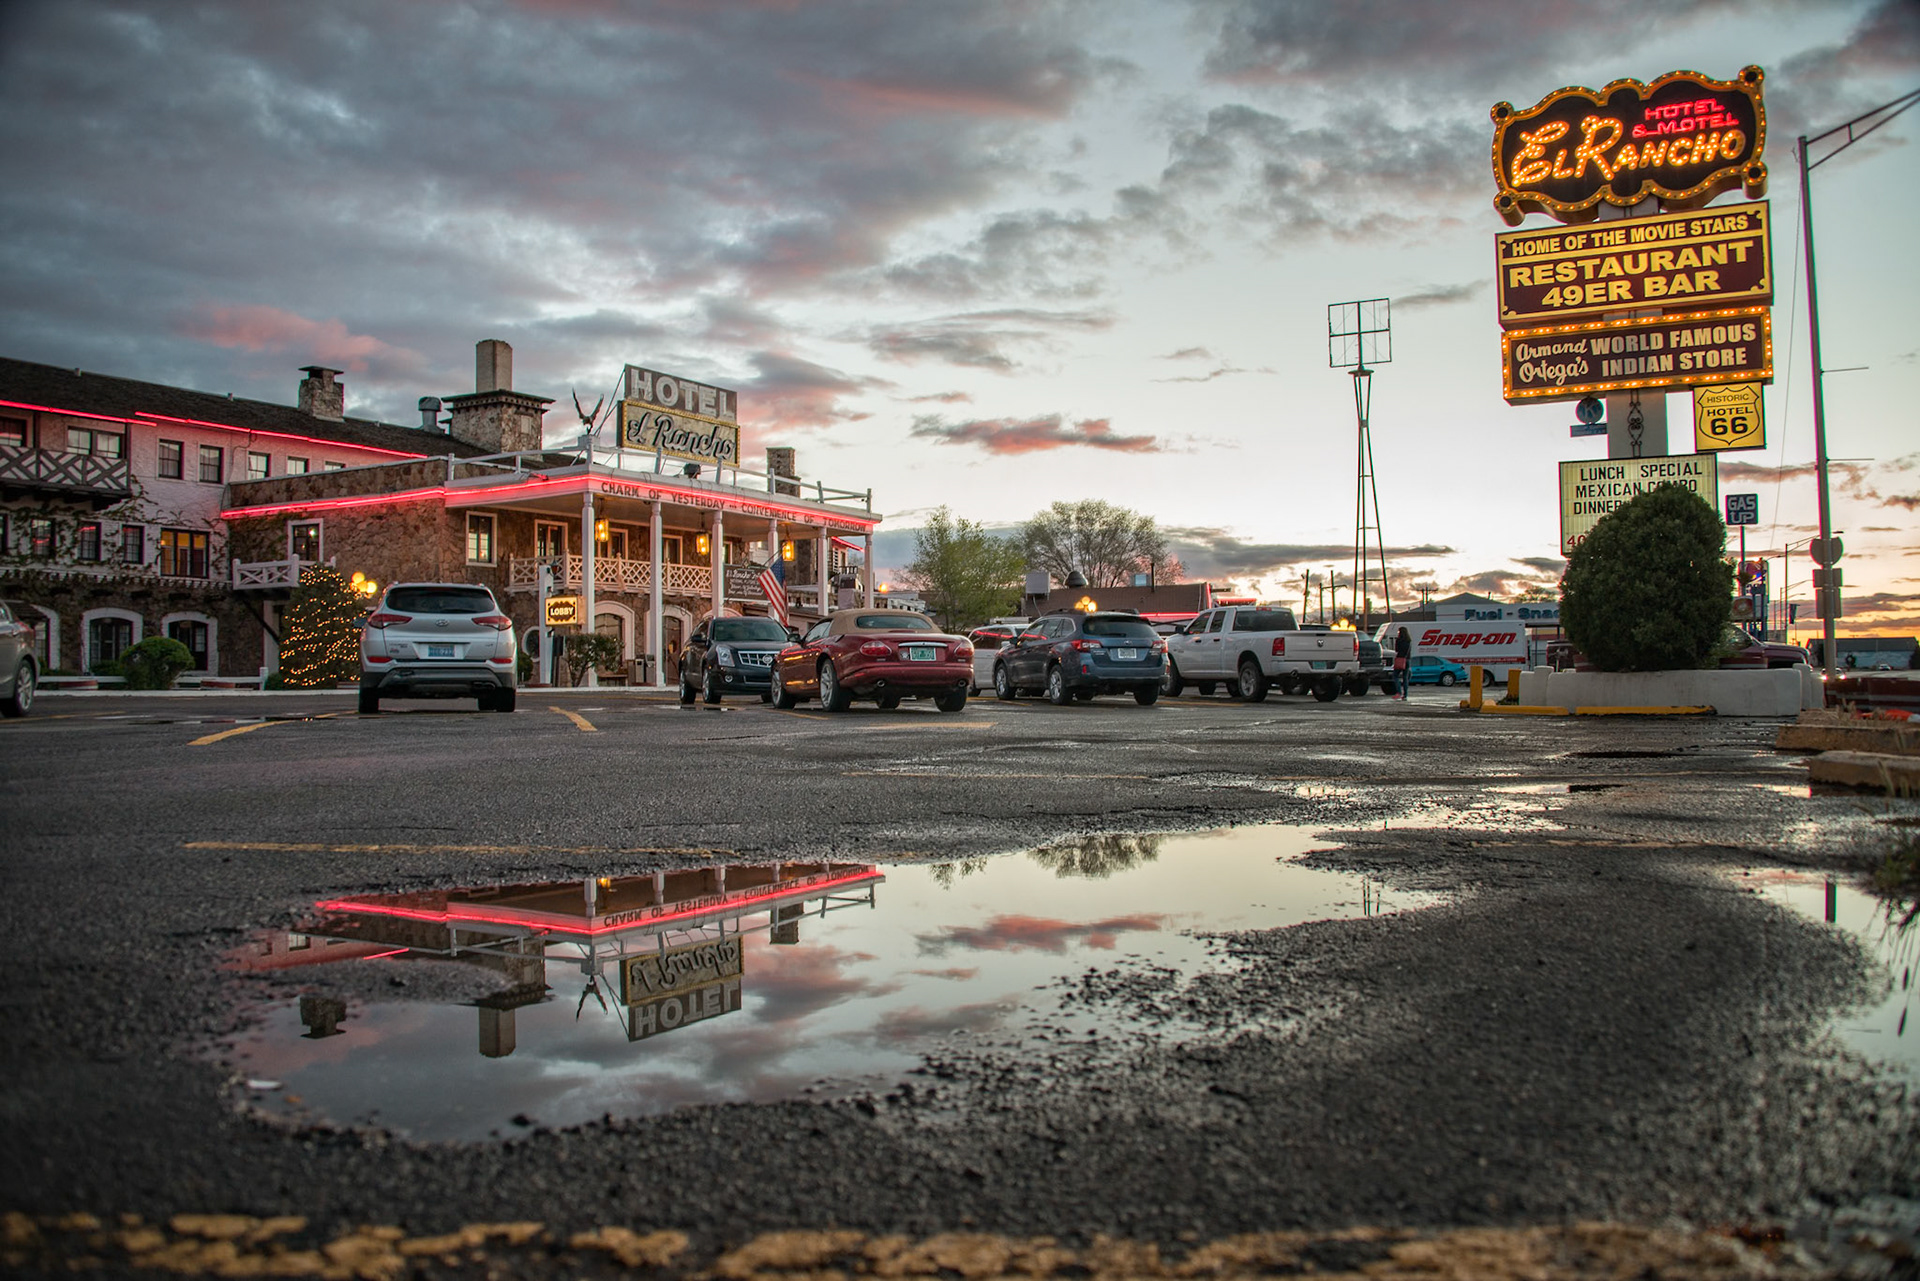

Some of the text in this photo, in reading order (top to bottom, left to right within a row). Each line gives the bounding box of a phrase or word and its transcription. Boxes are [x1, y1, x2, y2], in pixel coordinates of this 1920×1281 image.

[1645, 98, 1726, 120] HOTEL
[1632, 112, 1739, 138] & MOTEL
[1575, 115, 1746, 181] RANCHO
[1512, 214, 1749, 257] HOME OF THE MOVIE STARS
[1509, 240, 1755, 288] RESTAURANT
[1541, 270, 1721, 307] 49ER BAR
[1516, 338, 1588, 362] Armand
[1590, 323, 1757, 356] WORLD FAMOUS
[1518, 356, 1589, 386] Ortega's
[1602, 348, 1748, 377] INDIAN STORE
[631, 368, 735, 420] HOTEL
[1707, 393, 1749, 403] HISTORIC
[1707, 406, 1753, 416] HOTEL
[652, 414, 737, 460] Rancho
[1711, 416, 1748, 435] 66
[1580, 462, 1703, 481] LUNCH SPECIAL
[1576, 479, 1697, 498] MEXICAN CBO
[601, 482, 639, 498] CHARM
[648, 489, 661, 500] OF
[671, 494, 725, 510] YESTERDAY
[741, 503, 796, 521] CONVENIENCE
[804, 515, 814, 524] OF
[1728, 496, 1756, 510] GAS
[1730, 511, 1755, 524] UP
[550, 607, 574, 616] LOBBY
[1465, 608, 1502, 620] Fuel
[1418, 629, 1516, 649] Snap-on
